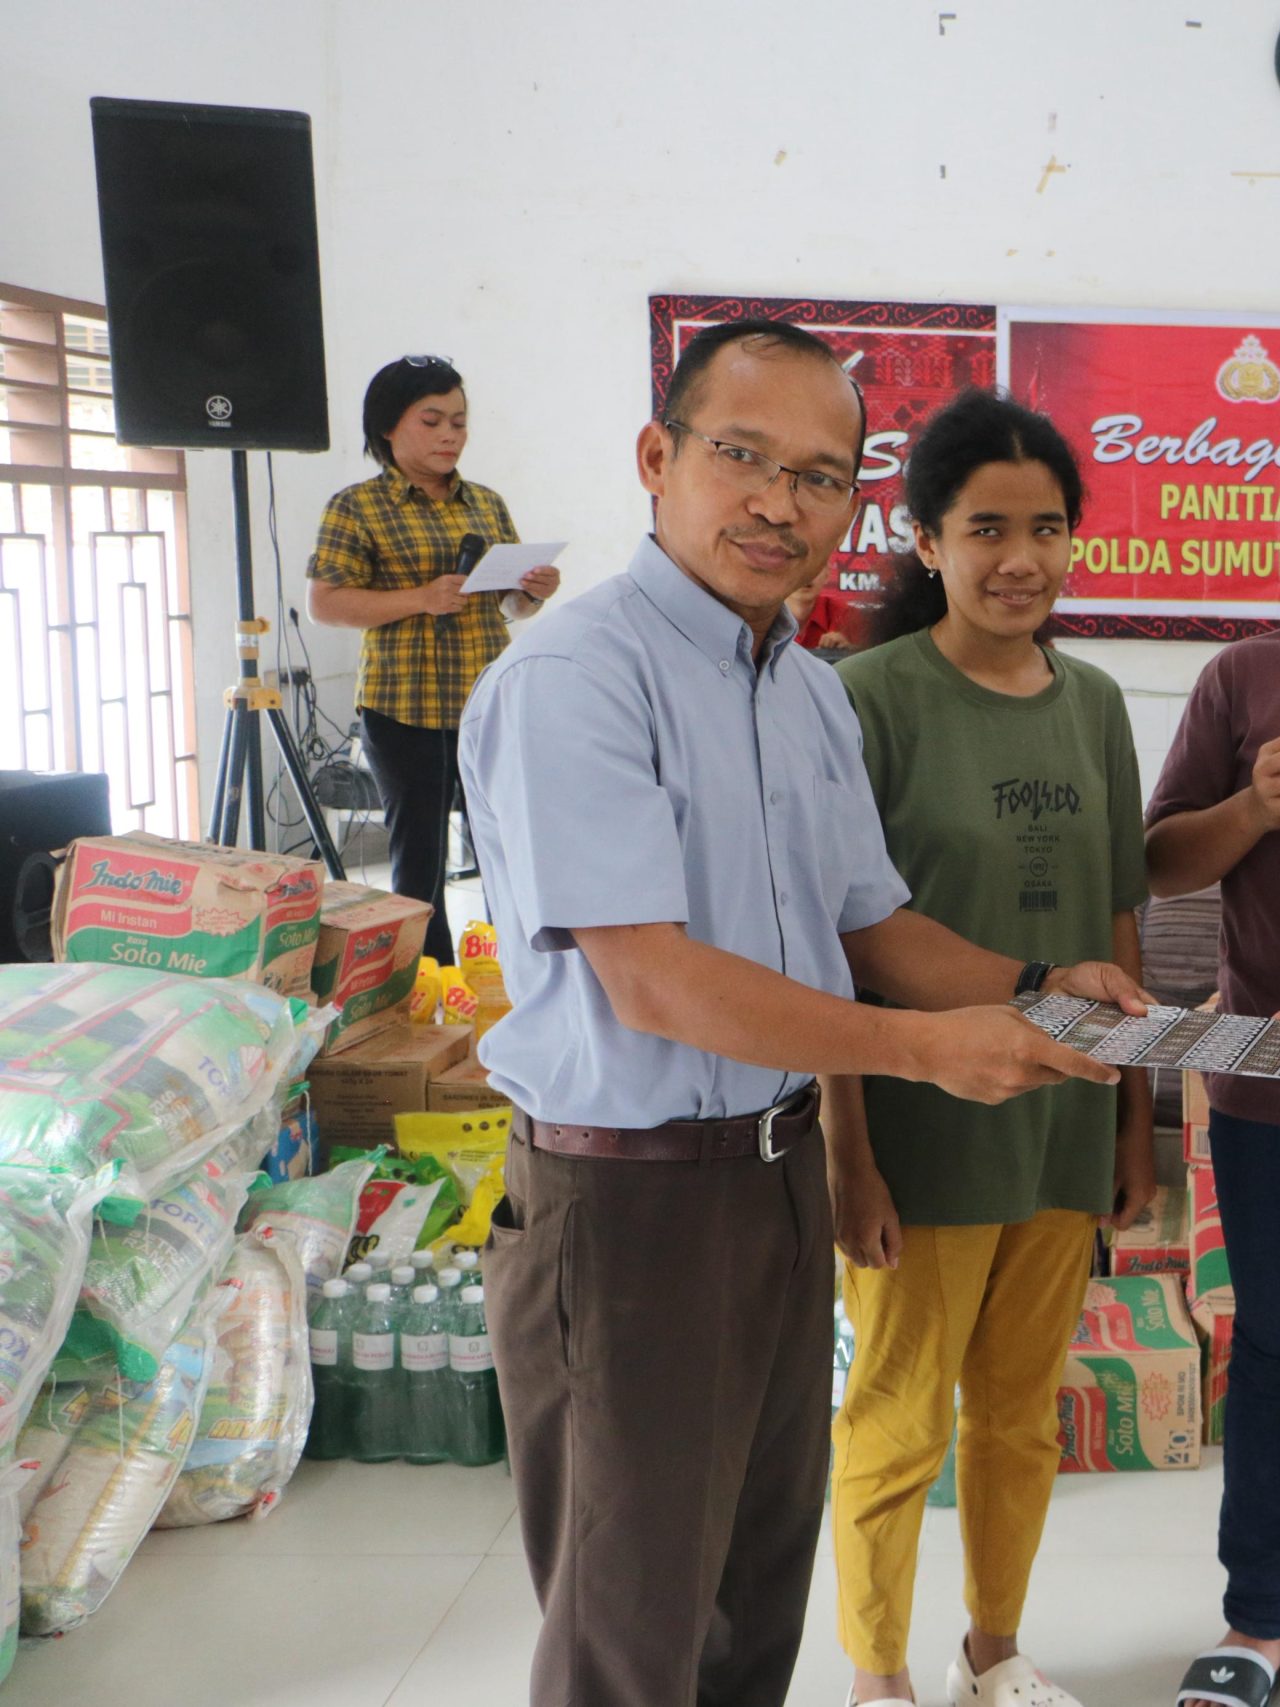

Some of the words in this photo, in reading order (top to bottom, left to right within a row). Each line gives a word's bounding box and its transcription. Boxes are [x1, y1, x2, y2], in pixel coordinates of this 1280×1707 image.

[1067, 537, 1172, 575] POLDA
[100, 909, 116, 922] Mi
[117, 911, 158, 930] Instan
[110, 943, 162, 966] Soto
[167, 950, 208, 974] Mie
[1115, 1417, 1135, 1456] Soto
